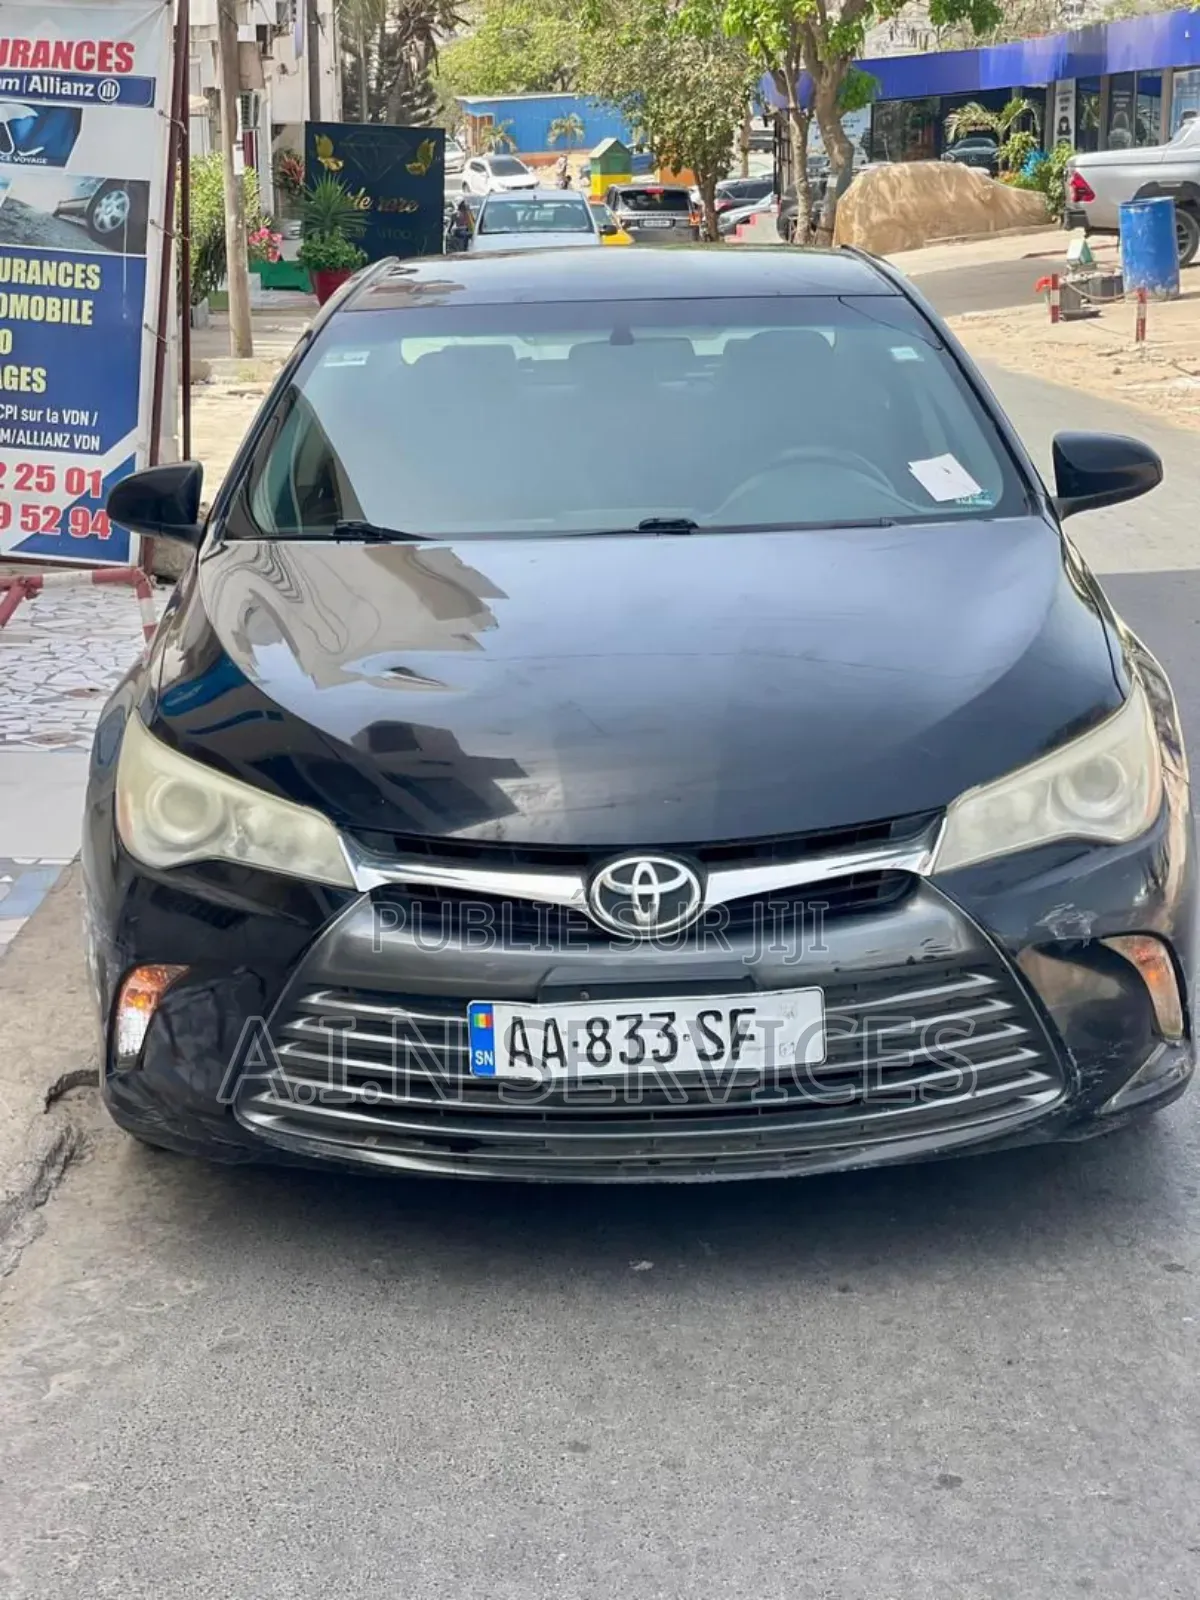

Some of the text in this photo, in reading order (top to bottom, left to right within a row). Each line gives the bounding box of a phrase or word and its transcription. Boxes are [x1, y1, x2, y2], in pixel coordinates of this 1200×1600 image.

[28, 74, 95, 97] Allianz
[0, 364, 47, 393] GES
[21, 408, 44, 422] sur
[46, 407, 59, 424] la
[62, 409, 89, 426] VDN
[73, 434, 101, 451] VDN
[14, 463, 56, 493] 25
[65, 467, 102, 498] 01
[20, 504, 61, 533] 52
[70, 508, 110, 539] 94
[475, 1051, 494, 1065] SN
